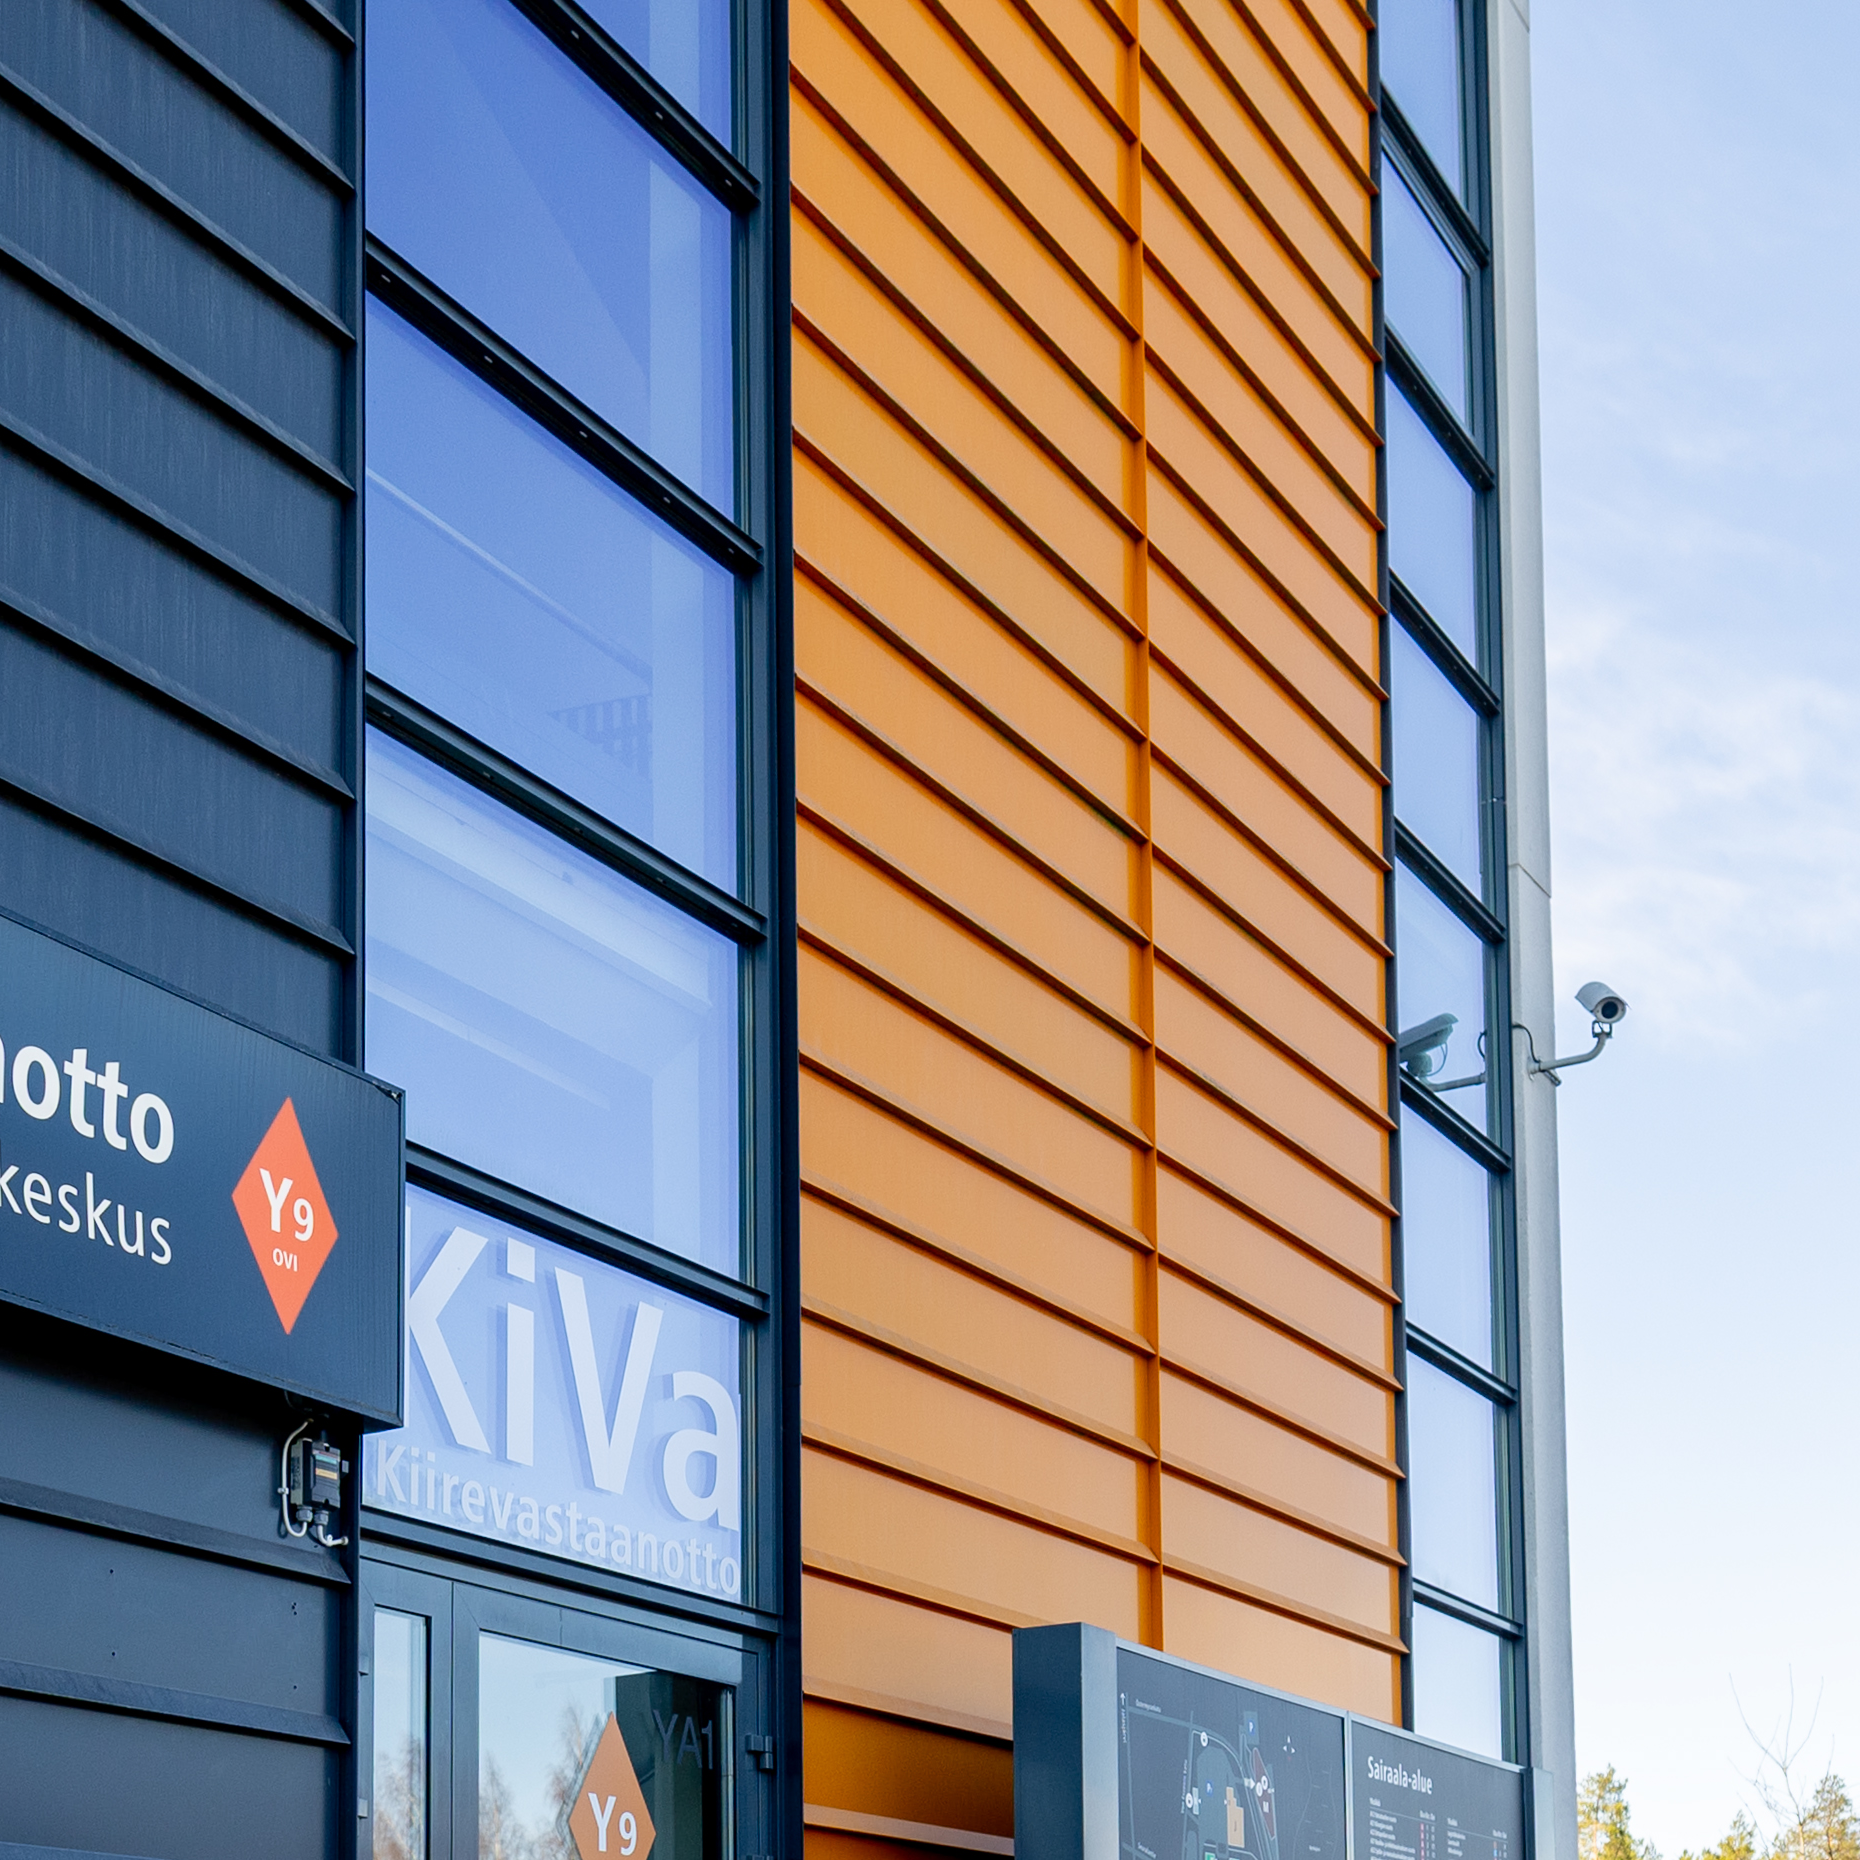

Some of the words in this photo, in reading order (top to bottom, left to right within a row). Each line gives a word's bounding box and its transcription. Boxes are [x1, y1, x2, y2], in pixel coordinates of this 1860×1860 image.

[259, 1167, 315, 1243] Y9
[272, 1247, 299, 1273] OVI
[404, 1206, 740, 1533] KiVa
[376, 1440, 740, 1597] Kiirevastaanotto
[653, 1709, 713, 1770] YA1
[1367, 1755, 1433, 1795] Sairaala-alue
[588, 1792, 638, 1857] Y9
